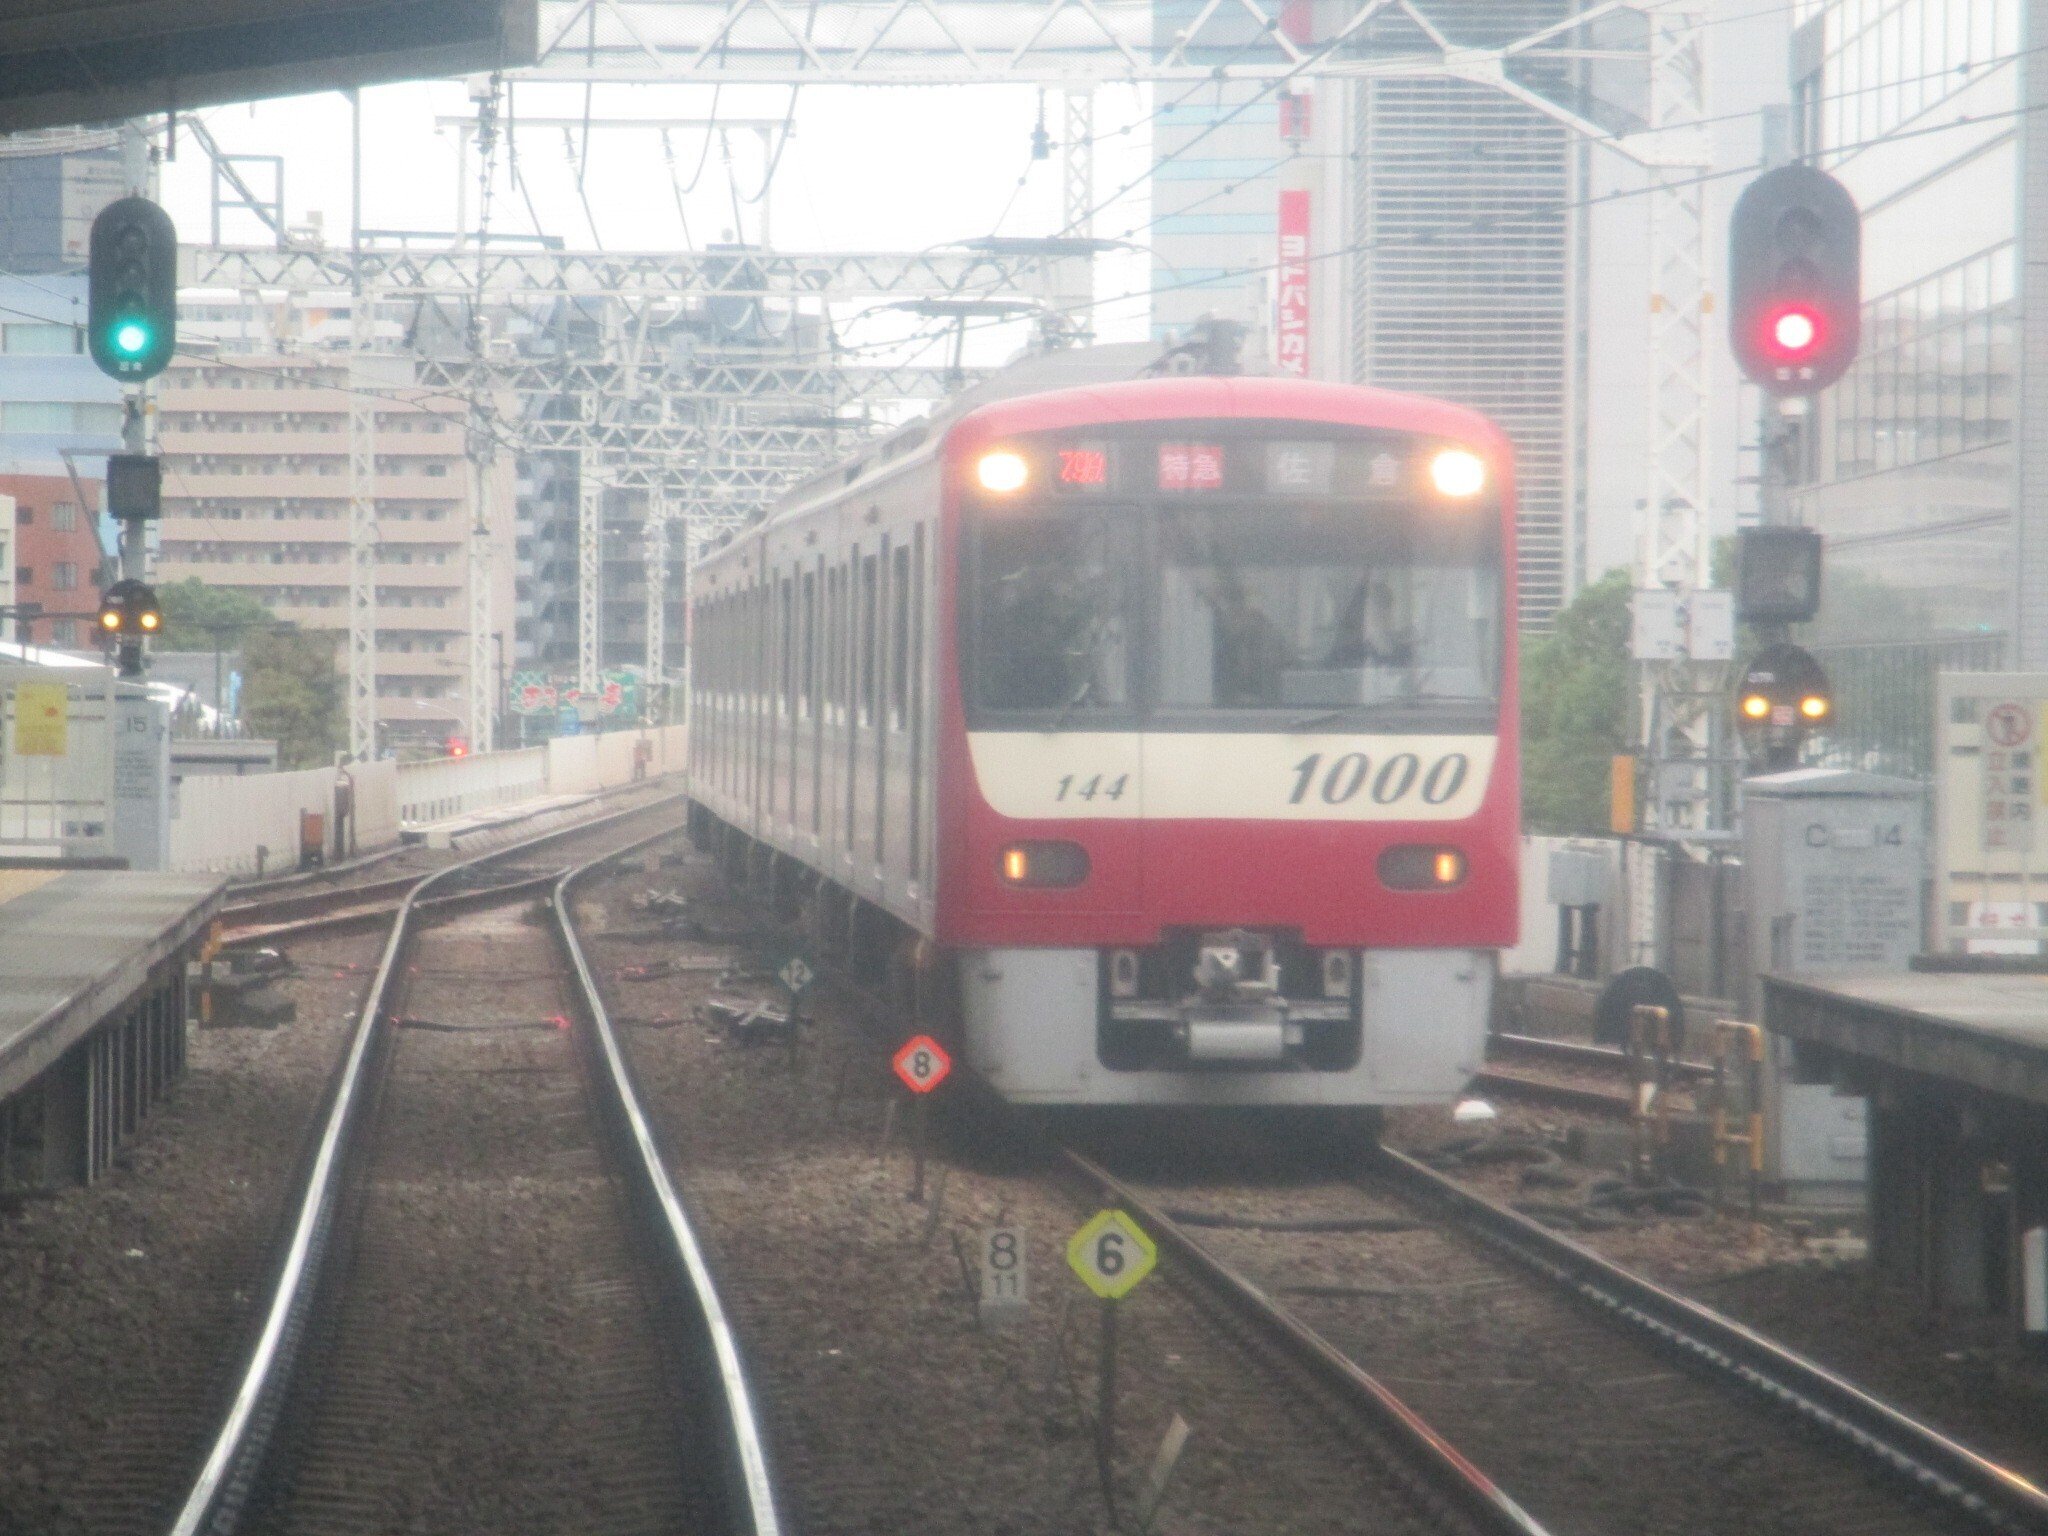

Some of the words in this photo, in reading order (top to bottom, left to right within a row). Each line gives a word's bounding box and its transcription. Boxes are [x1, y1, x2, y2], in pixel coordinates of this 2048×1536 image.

[1161, 454, 1222, 481] 特急
[126, 715, 148, 733] 15
[1055, 773, 1130, 802] 144
[1287, 752, 1470, 805] 1000
[1805, 823, 1828, 848] C
[914, 1051, 930, 1078] 8
[989, 1232, 1018, 1271] 8
[1096, 1232, 1126, 1277] 6
[992, 1273, 1018, 1297] 11
